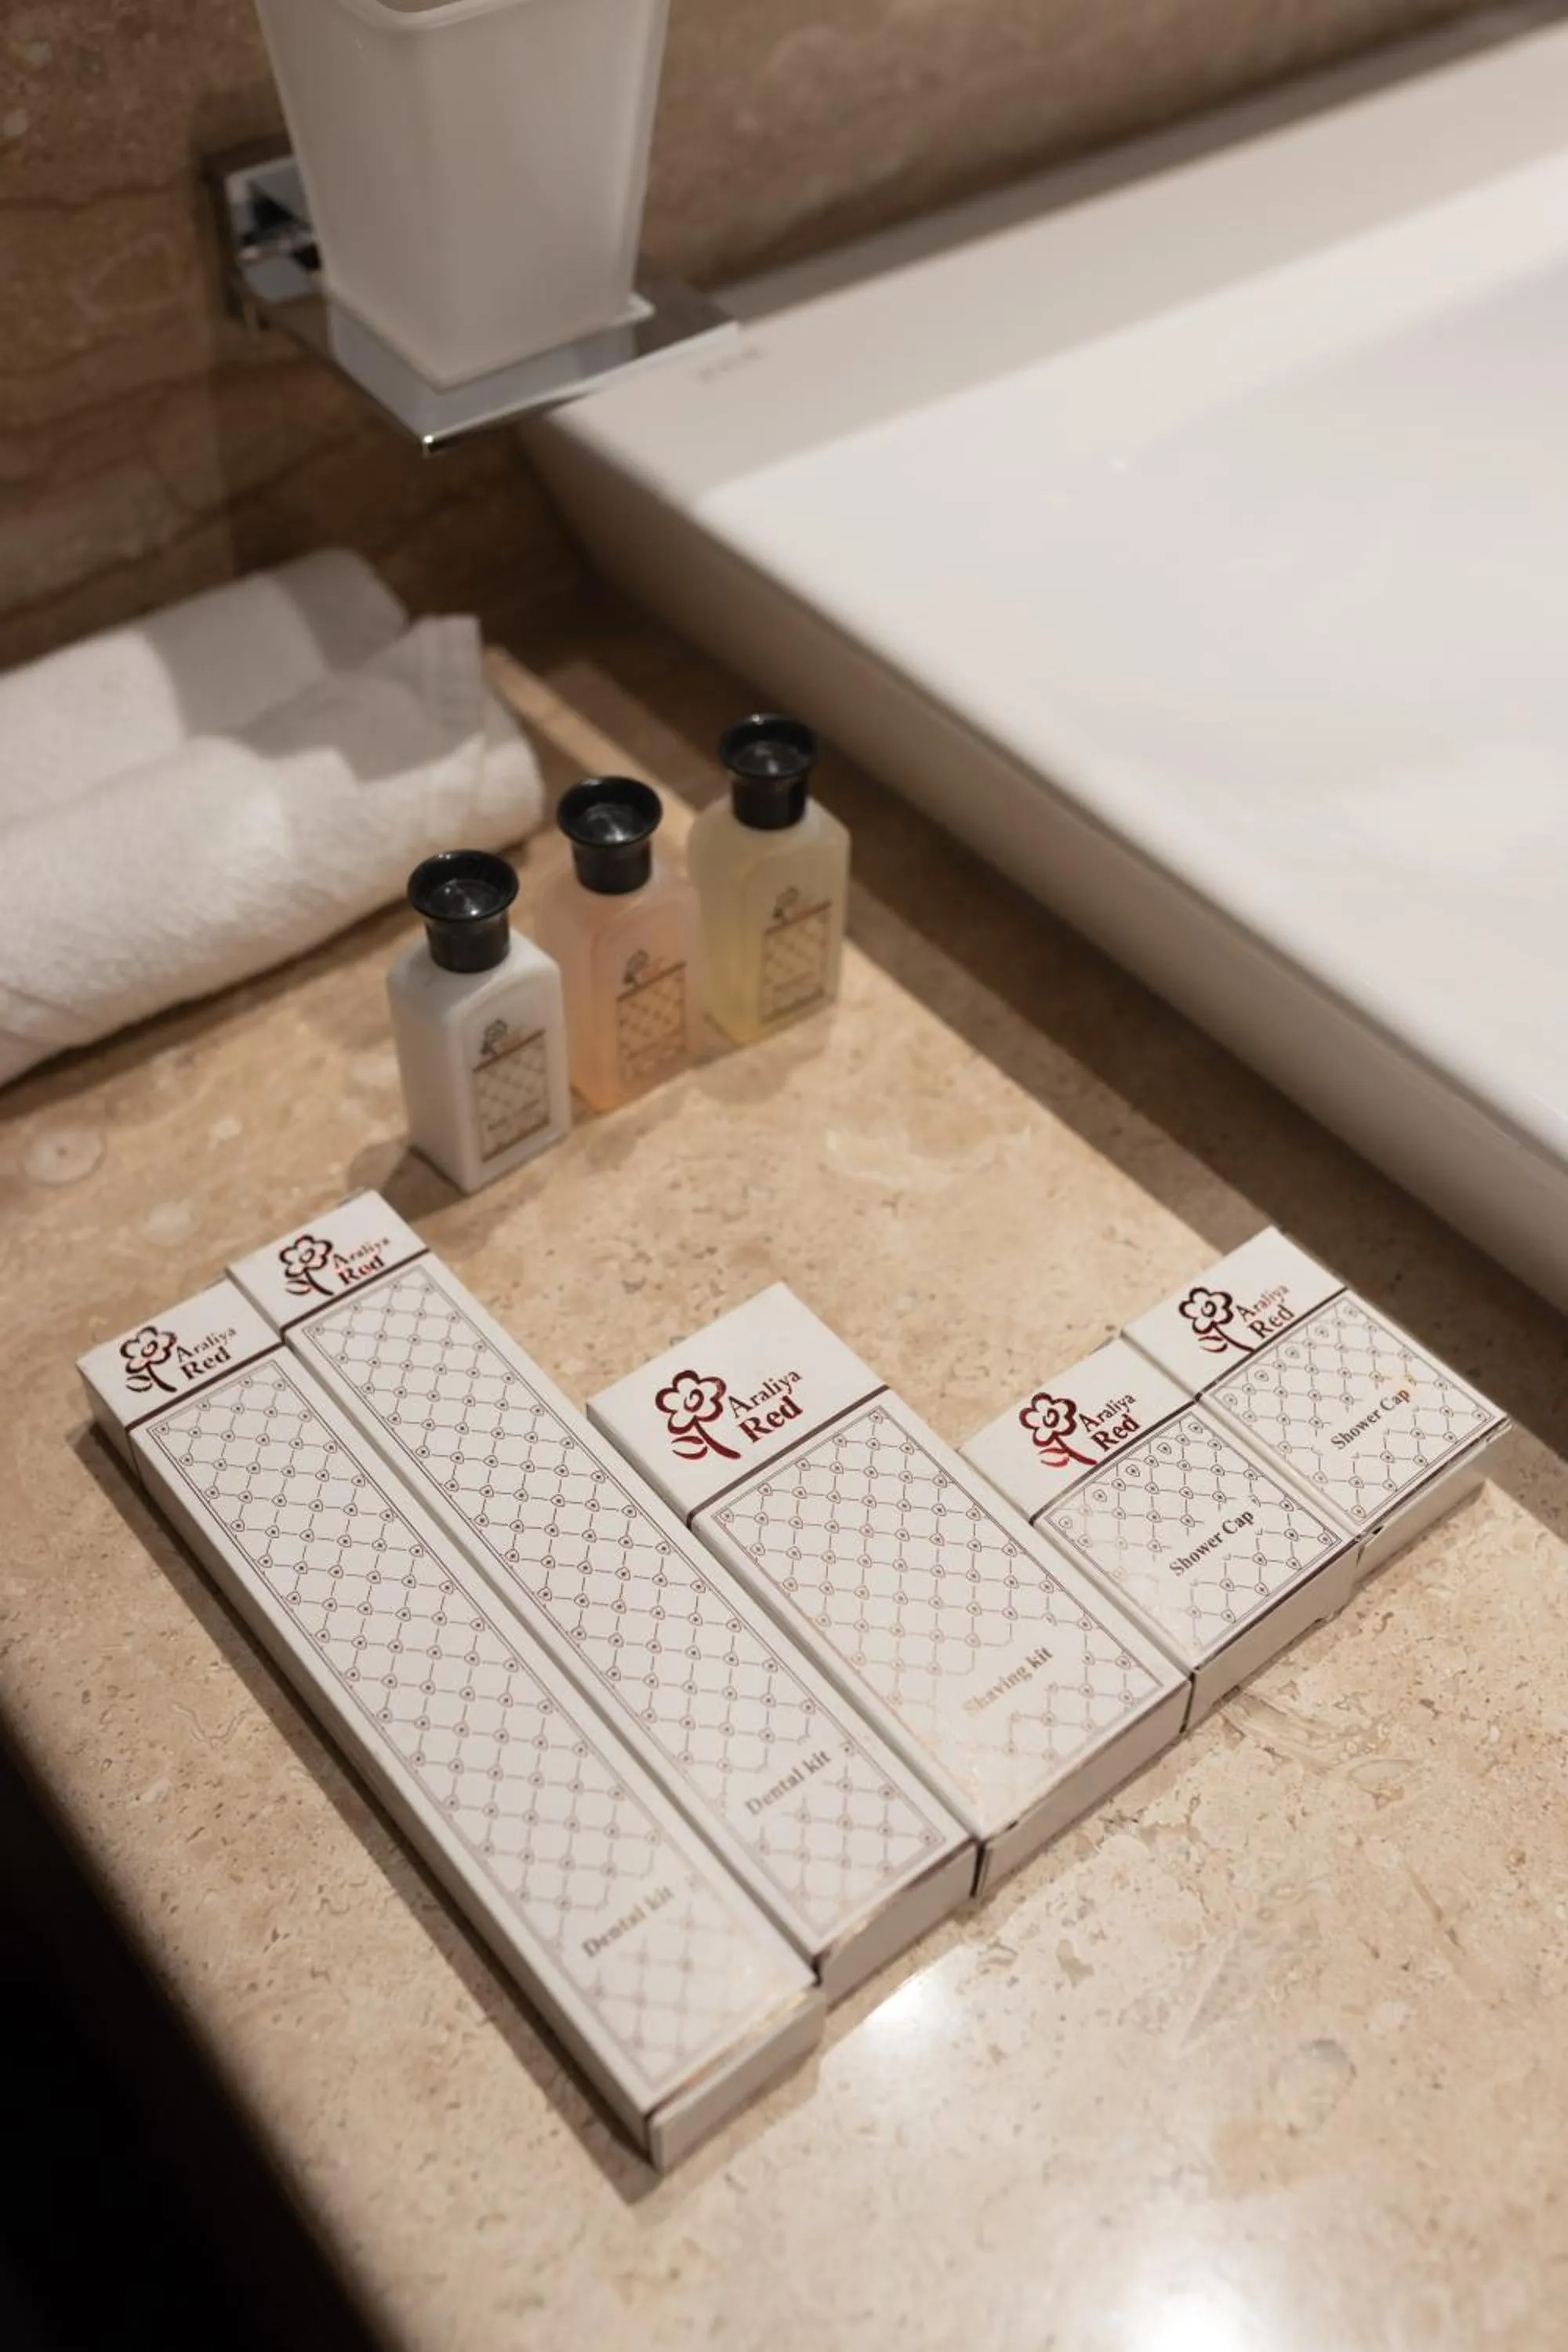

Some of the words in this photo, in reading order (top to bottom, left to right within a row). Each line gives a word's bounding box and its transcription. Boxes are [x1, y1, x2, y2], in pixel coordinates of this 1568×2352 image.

[332, 1236, 390, 1269] Araliya
[336, 1256, 386, 1285] Red
[1236, 1285, 1290, 1323] Araliya
[1249, 1304, 1295, 1339] Red
[176, 1327, 238, 1363] Araliya
[180, 1346, 232, 1381] Red
[728, 1370, 802, 1419] Araliya
[1078, 1392, 1137, 1432] Araliya
[739, 1395, 804, 1443] Red
[1091, 1413, 1141, 1452] Red
[1330, 1408, 1382, 1450] Shower
[1379, 1388, 1411, 1412] Cap
[1169, 1530, 1224, 1576] Shower
[1221, 1510, 1255, 1535] Cap
[963, 1665, 1033, 1715] Shaving
[1026, 1646, 1054, 1671] kit
[745, 1766, 805, 1816] Dental
[801, 1750, 833, 1775] kit
[582, 1904, 646, 1958] Dental
[643, 1886, 675, 1912] kit
